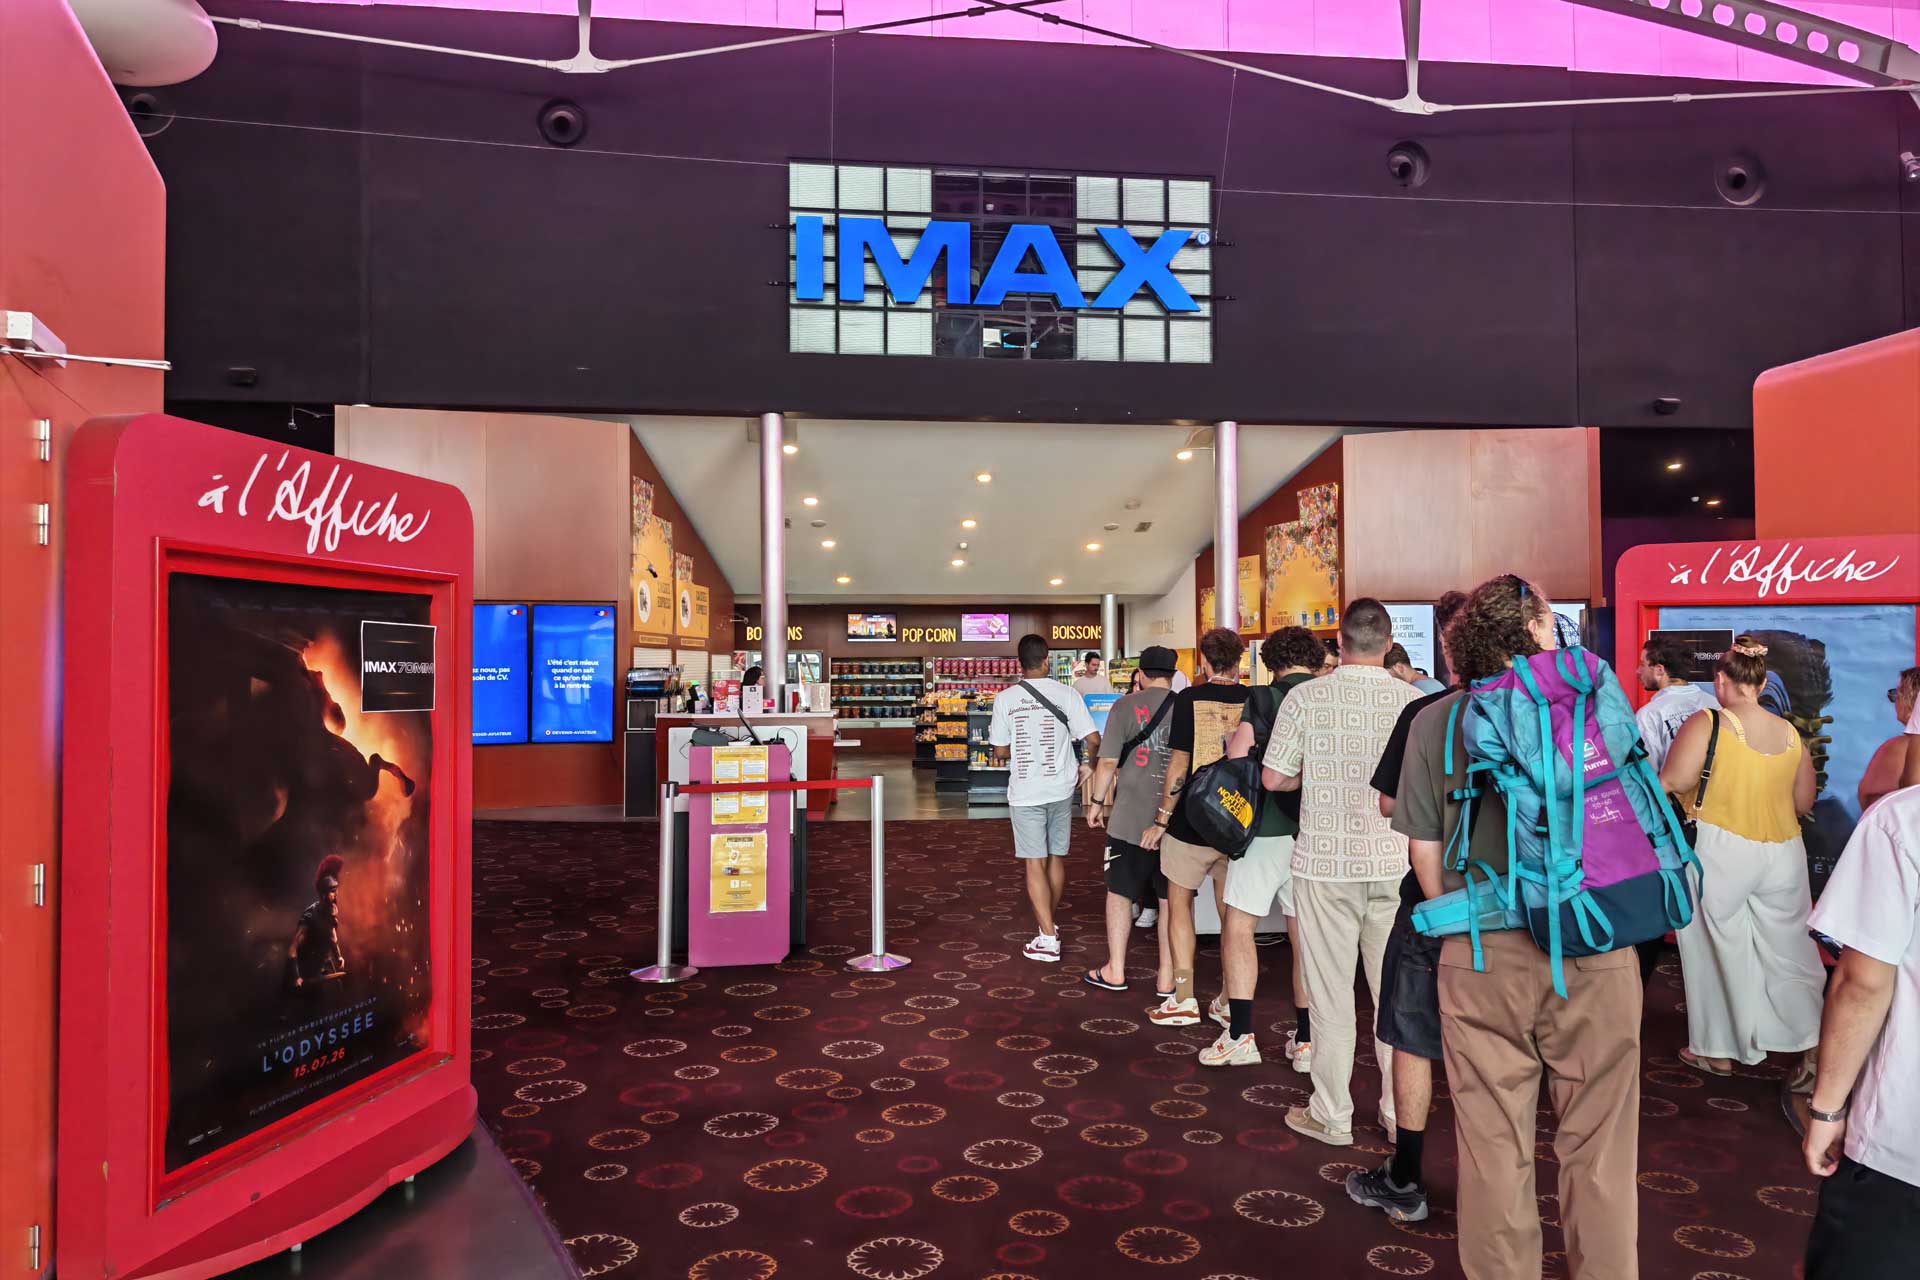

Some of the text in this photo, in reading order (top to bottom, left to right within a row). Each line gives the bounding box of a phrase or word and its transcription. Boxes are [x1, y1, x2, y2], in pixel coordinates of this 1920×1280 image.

[746, 626, 803, 641] BONS
[902, 627, 957, 643] POP CORN
[364, 660, 397, 673] IMAX
[498, 667, 511, 675] pas
[581, 674, 593, 682] fait
[1217, 786, 1243, 811] NORTH
[1233, 790, 1246, 807] THE
[1220, 799, 1240, 817] FACE
[263, 1011, 374, 1073] L'ODYSSÉE
